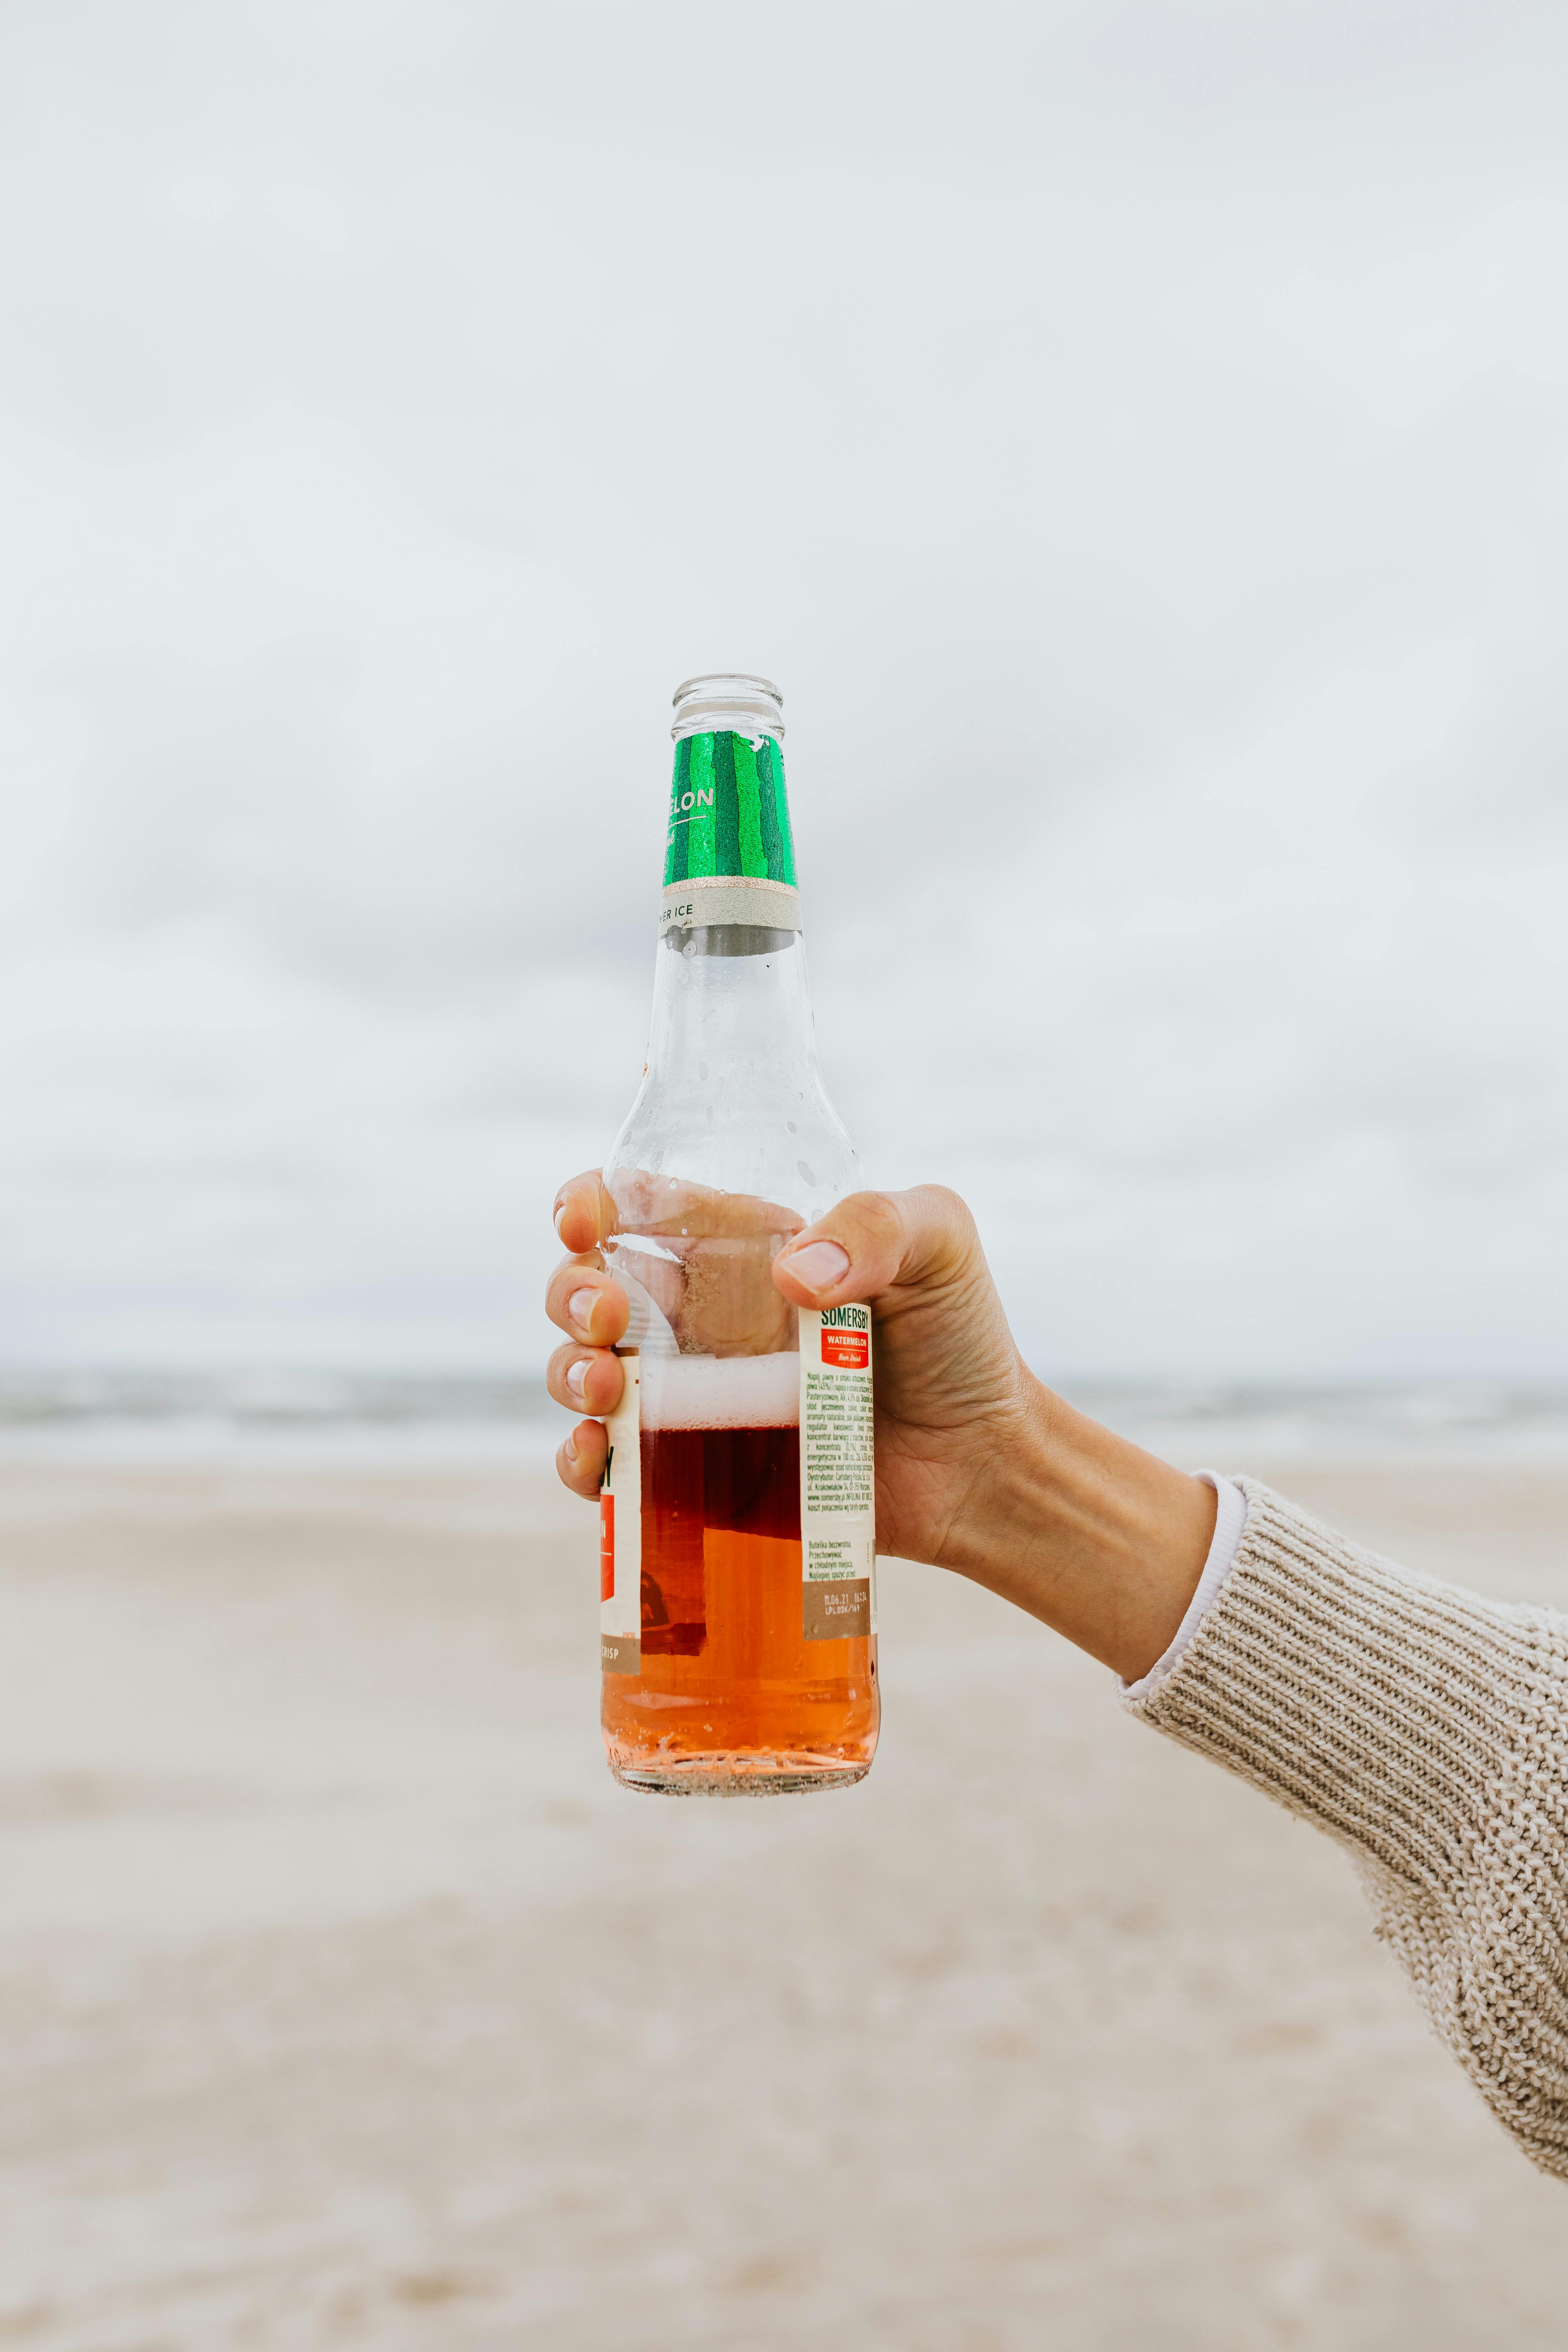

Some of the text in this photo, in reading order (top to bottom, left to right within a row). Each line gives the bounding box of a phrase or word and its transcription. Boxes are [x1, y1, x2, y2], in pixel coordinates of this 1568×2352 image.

[675, 904, 693, 917] ICE
[821, 1307, 868, 1330] SOMERSBY
[827, 1335, 867, 1347] WATERMELON
[838, 1353, 849, 1361] Beer
[809, 1540, 827, 1548] Butelka
[809, 1550, 842, 1560] Przechowywać
[809, 1571, 830, 1582] Najlepiej
[824, 1593, 849, 1606] 11.06.21
[601, 1645, 619, 1660] CRISP
